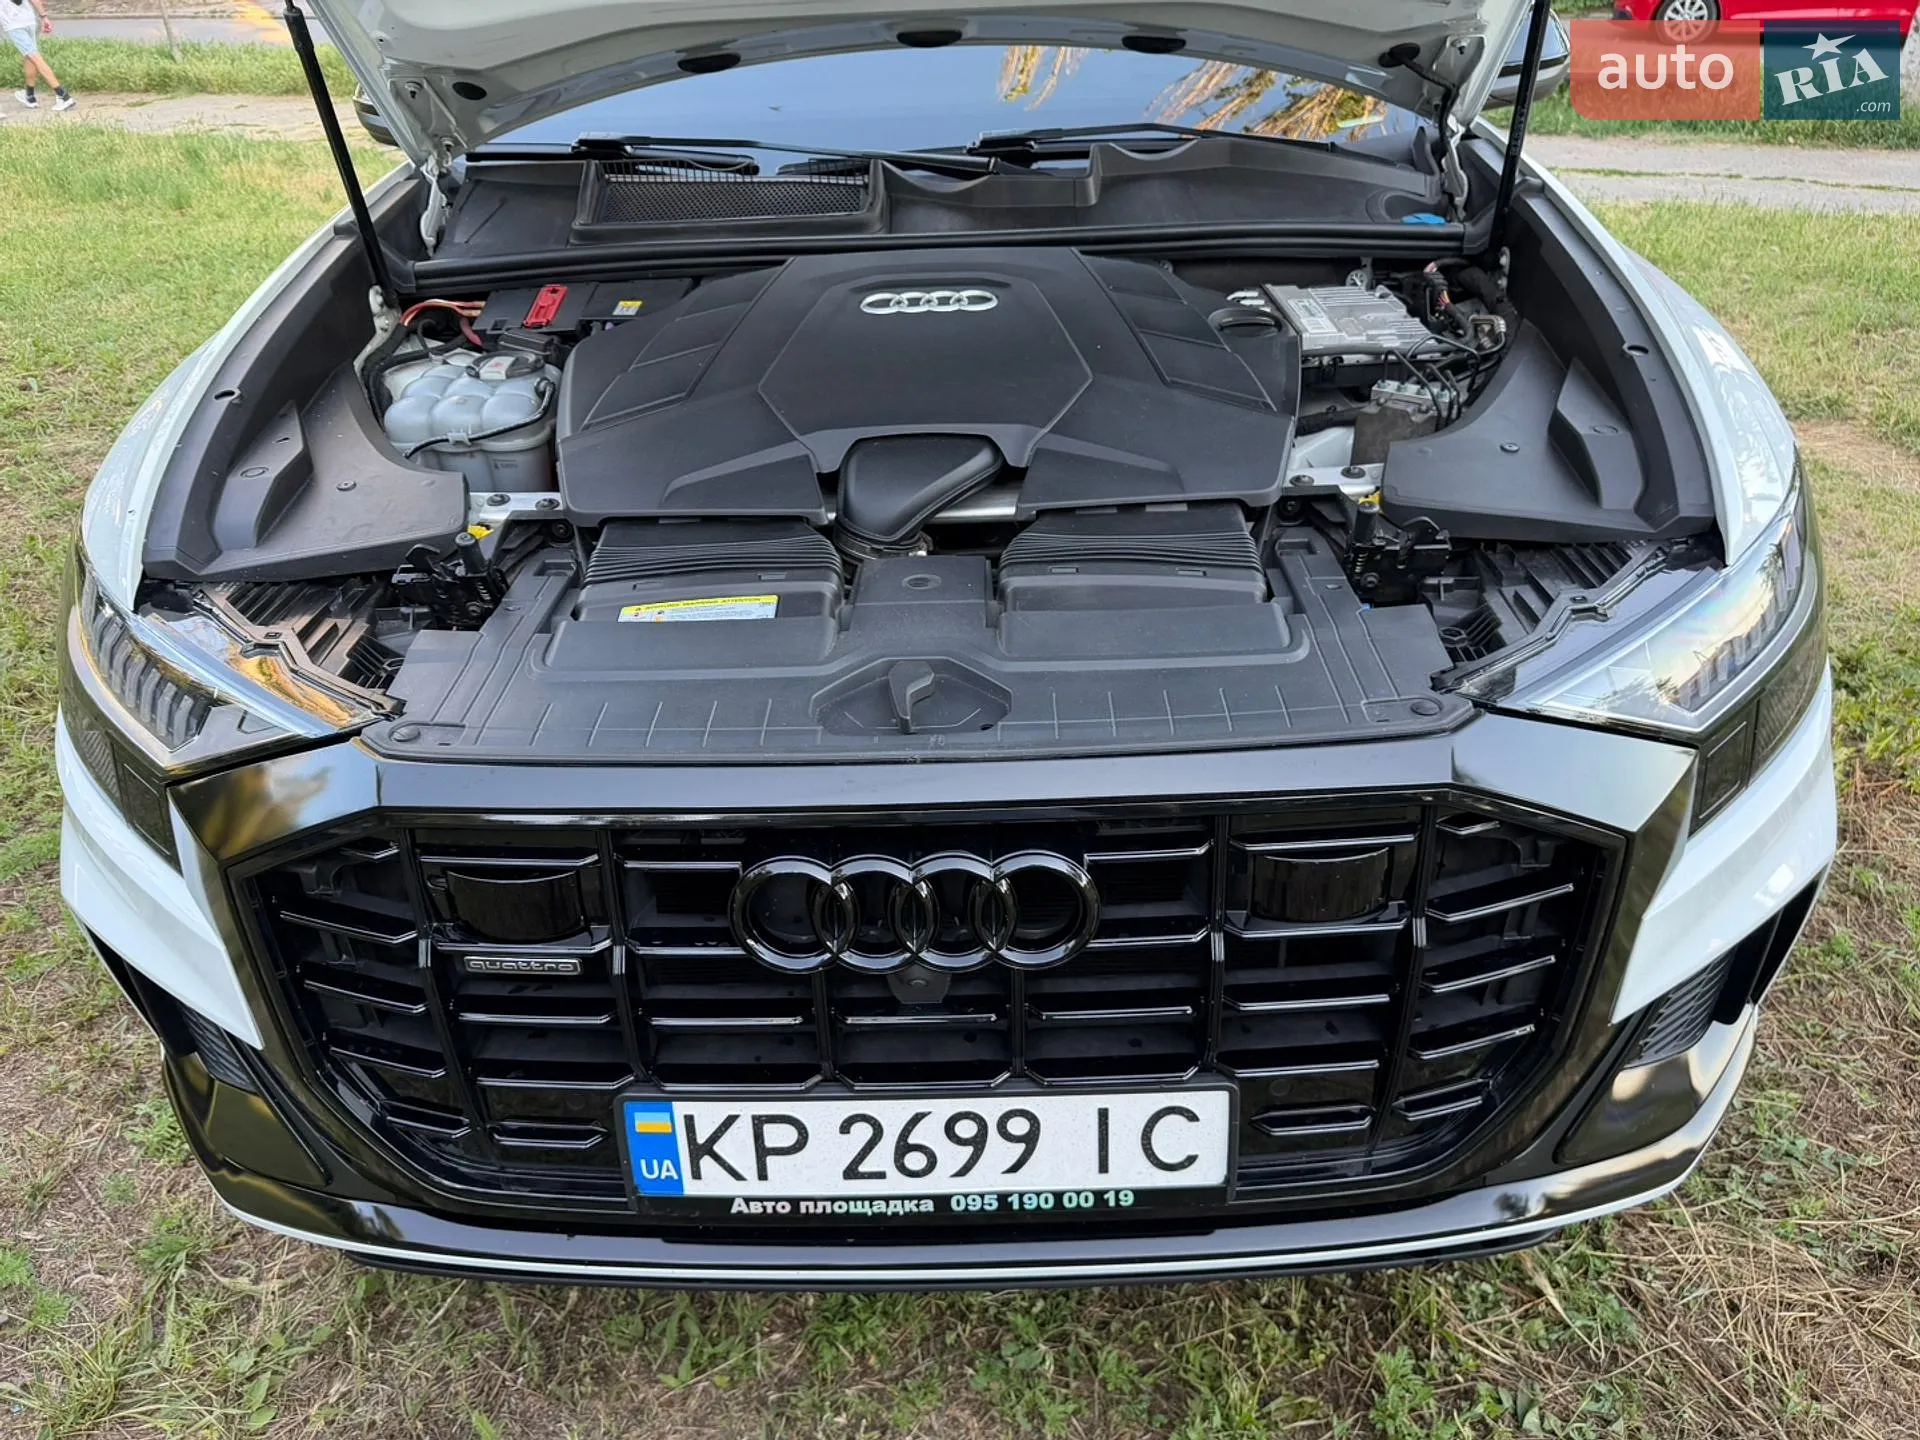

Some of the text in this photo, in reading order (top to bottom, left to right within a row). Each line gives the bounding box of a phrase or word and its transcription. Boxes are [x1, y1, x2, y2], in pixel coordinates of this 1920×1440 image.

[469, 960, 574, 970] quattro
[683, 1114, 809, 1181] KP
[838, 1108, 1041, 1180] 2699
[640, 1159, 678, 1180] UA
[730, 1189, 1135, 1216] Авто площадка 095 190 00 19
